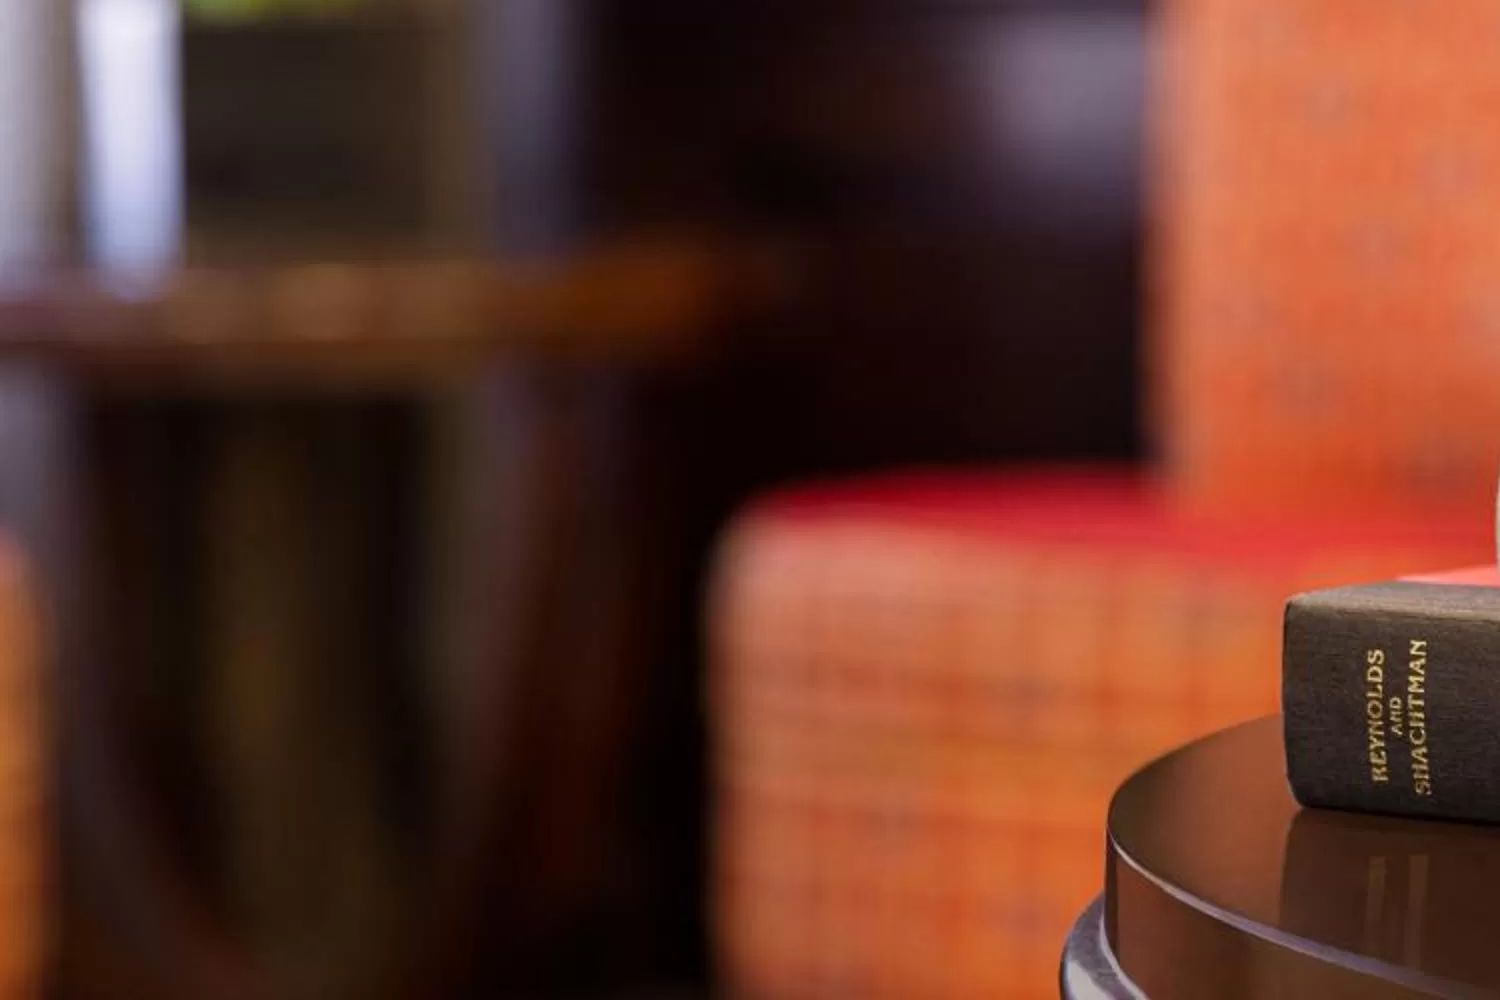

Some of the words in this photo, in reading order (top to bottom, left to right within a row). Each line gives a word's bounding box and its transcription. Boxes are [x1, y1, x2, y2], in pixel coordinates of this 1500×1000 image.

[1366, 648, 1389, 784] REYNOLDS
[1389, 697, 1404, 737] AND
[1408, 638, 1433, 796] SHACHTMAN
